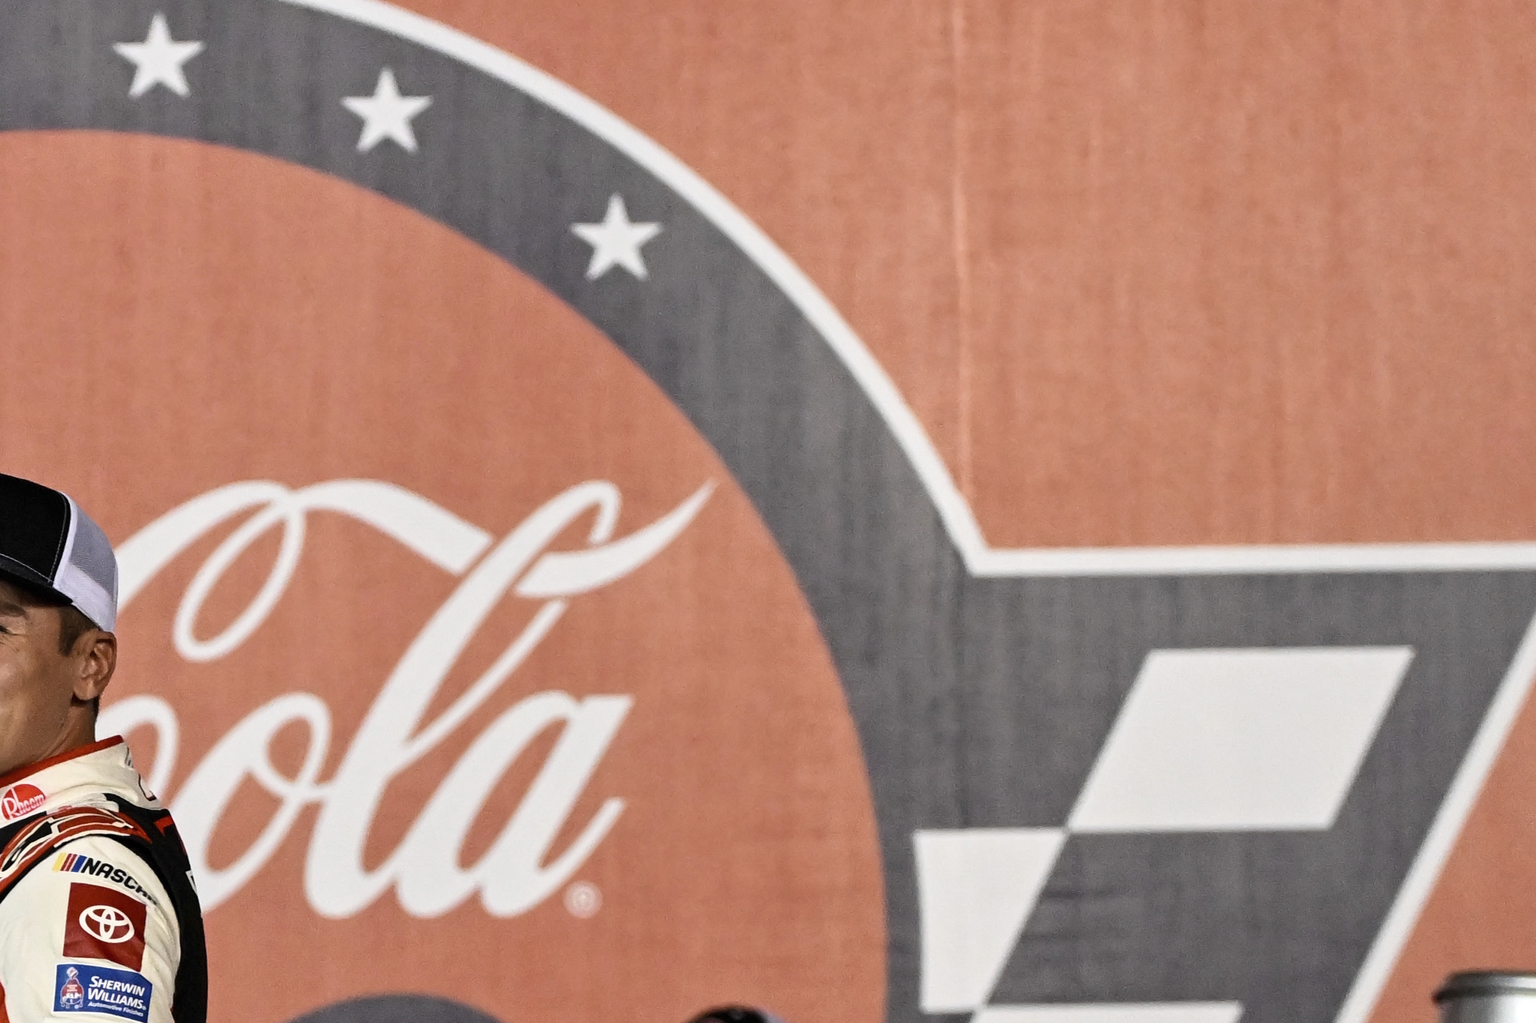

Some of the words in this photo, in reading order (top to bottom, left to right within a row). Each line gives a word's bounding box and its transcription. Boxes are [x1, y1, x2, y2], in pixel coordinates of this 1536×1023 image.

[80, 857, 158, 906] NASC
[89, 976, 145, 997] SHERWIN
[87, 988, 144, 1010] WILLIAMS
[88, 1001, 122, 1012] Automotive
